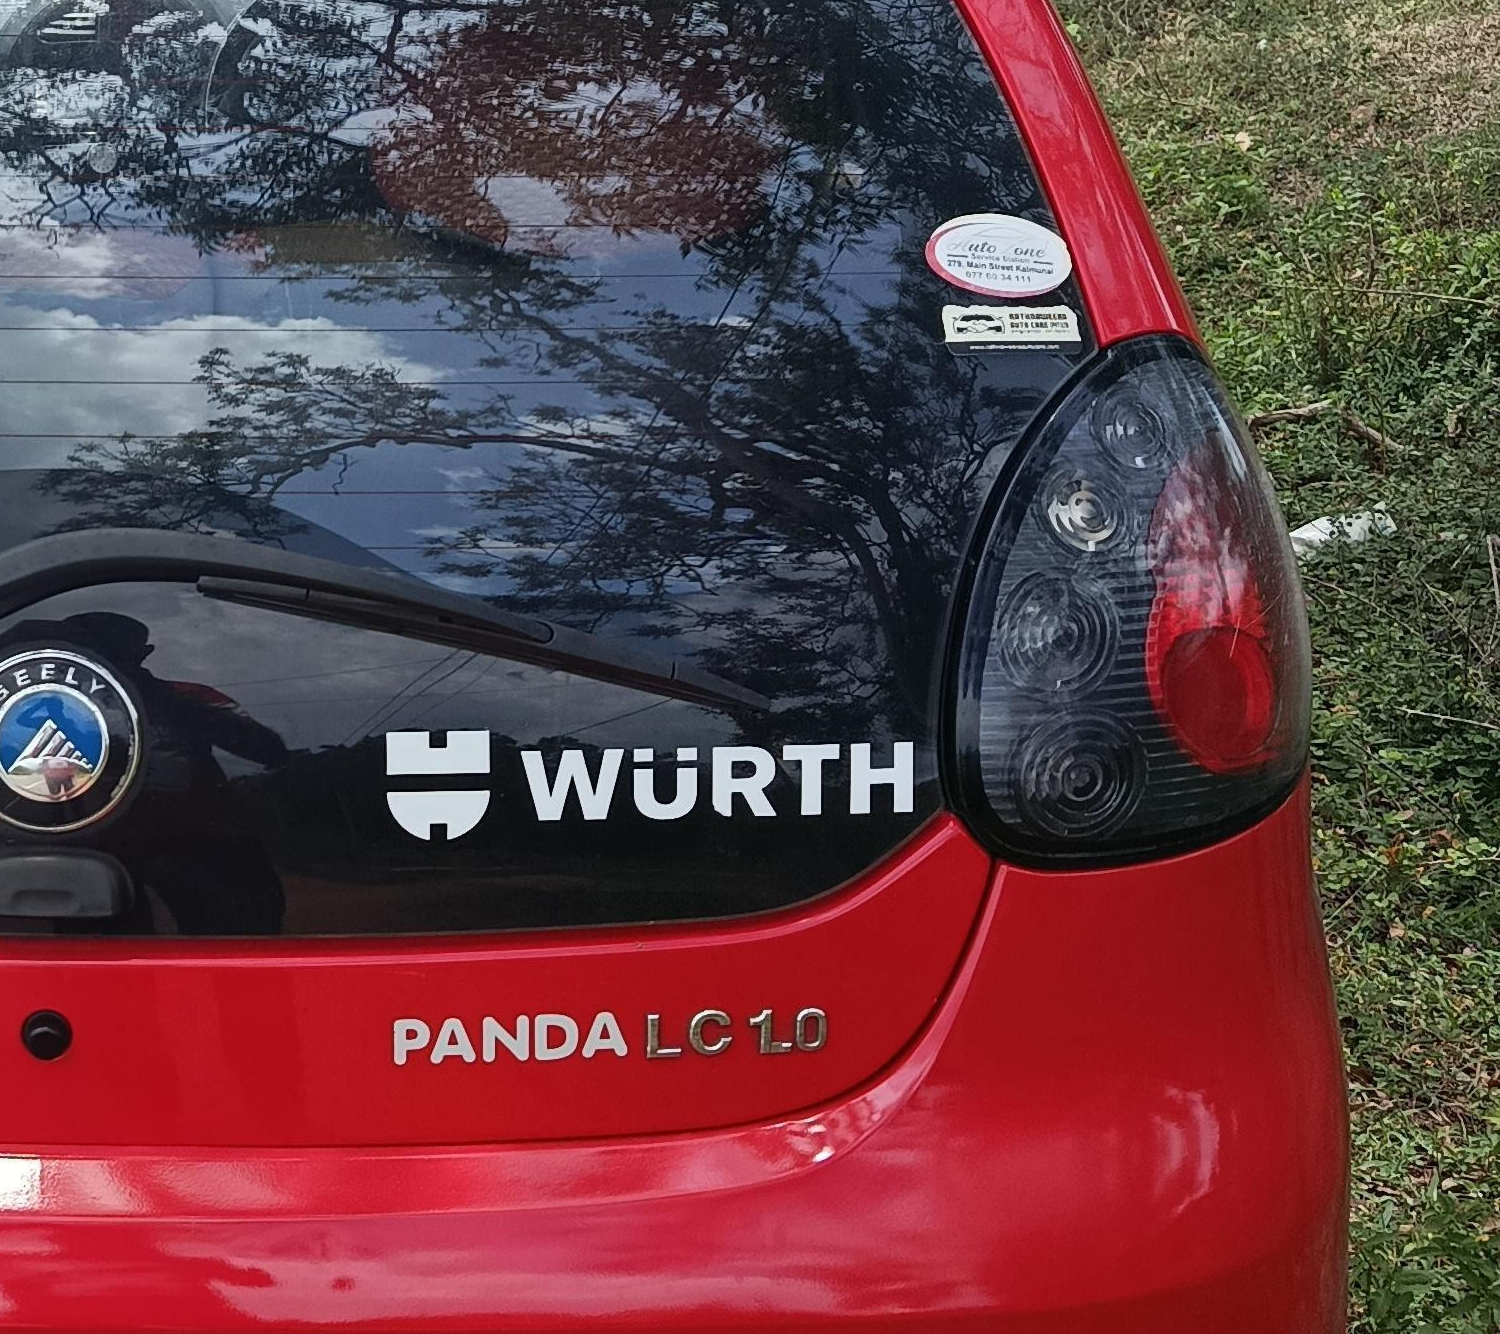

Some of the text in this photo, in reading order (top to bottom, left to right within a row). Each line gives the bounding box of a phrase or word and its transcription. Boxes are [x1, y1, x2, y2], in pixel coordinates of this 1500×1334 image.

[948, 238, 997, 254] Auto
[966, 260, 987, 269] Main
[988, 262, 1014, 272] Street
[520, 741, 914, 821] WÜRTH
[393, 1007, 828, 1065] PANDA LC 1.0
